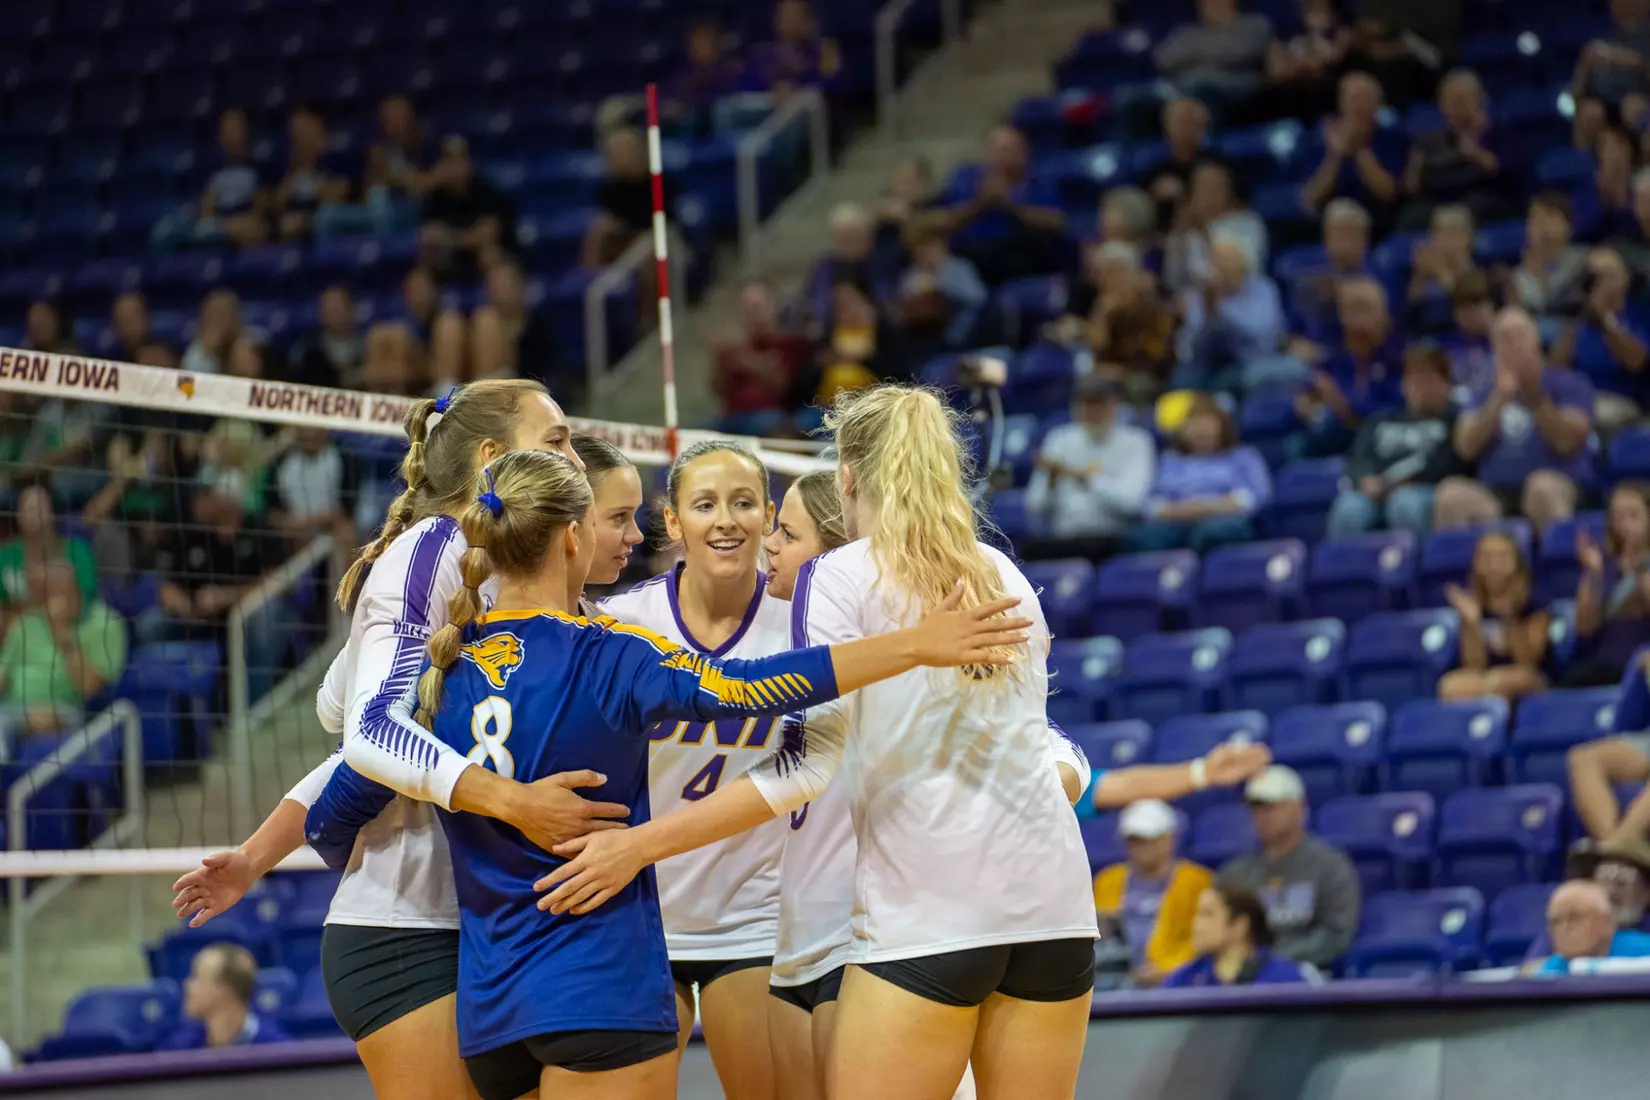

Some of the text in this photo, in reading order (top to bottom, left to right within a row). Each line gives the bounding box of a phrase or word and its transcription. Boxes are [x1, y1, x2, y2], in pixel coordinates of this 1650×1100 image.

[57, 360, 119, 391] IOWA
[248, 384, 362, 419] NORTHERN
[465, 694, 515, 779] 8
[681, 753, 728, 800] 4
